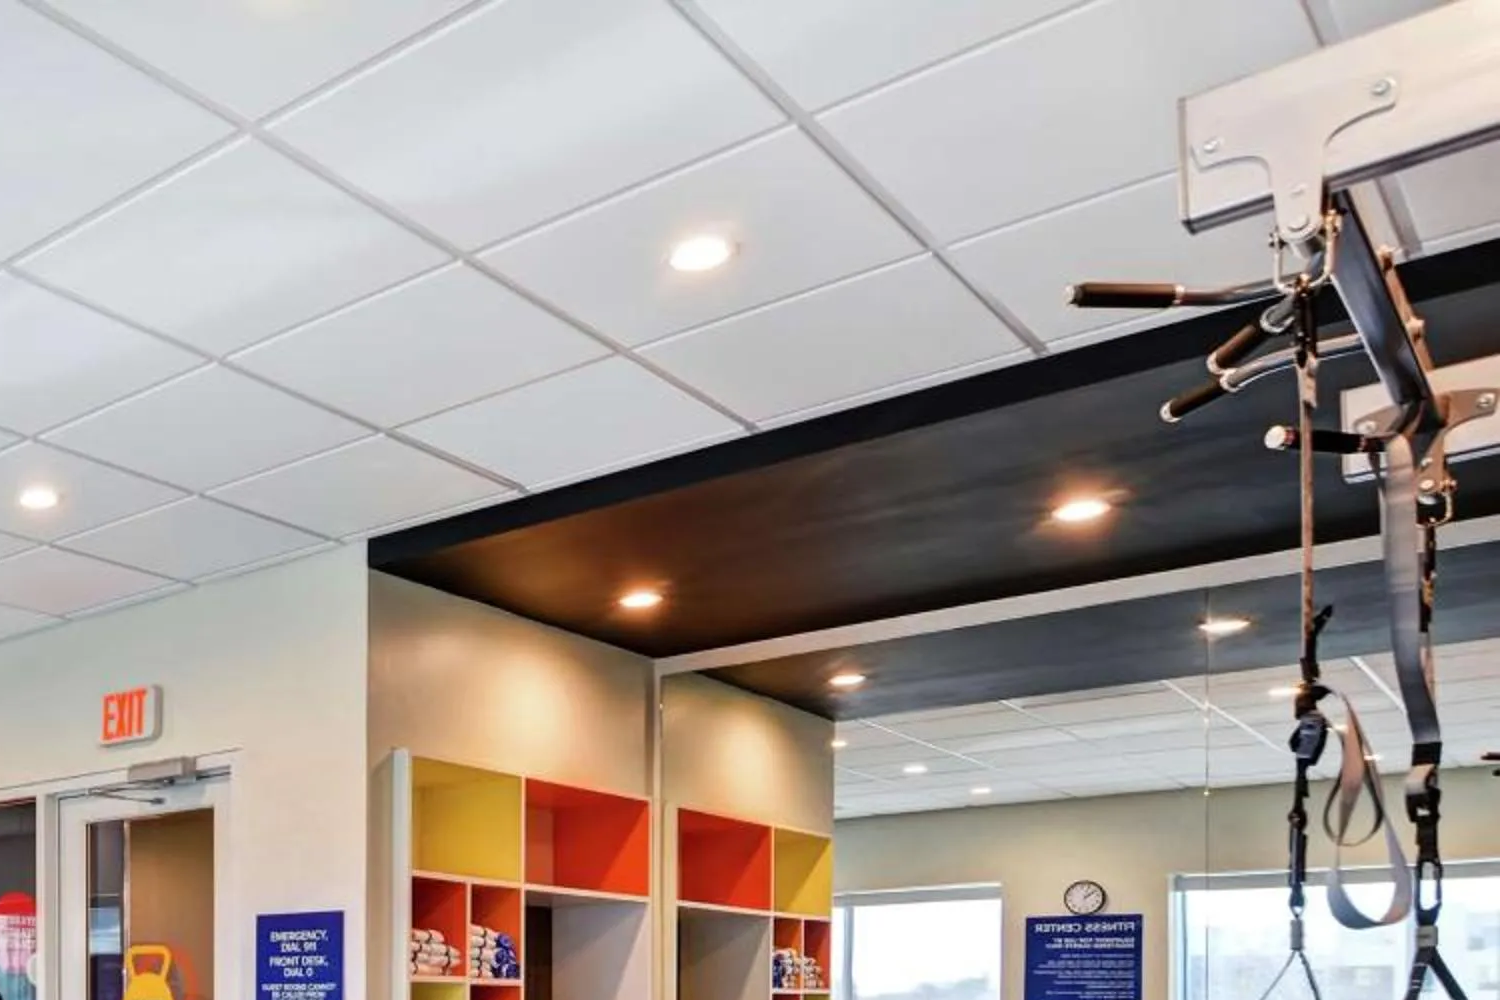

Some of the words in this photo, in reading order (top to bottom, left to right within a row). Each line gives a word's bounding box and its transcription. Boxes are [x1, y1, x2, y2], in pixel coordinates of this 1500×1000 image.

[103, 688, 146, 740] EXIT
[281, 942, 302, 953] DIAL
[303, 941, 317, 952] 911
[269, 955, 300, 967] FRONT
[283, 967, 304, 977] DIAL
